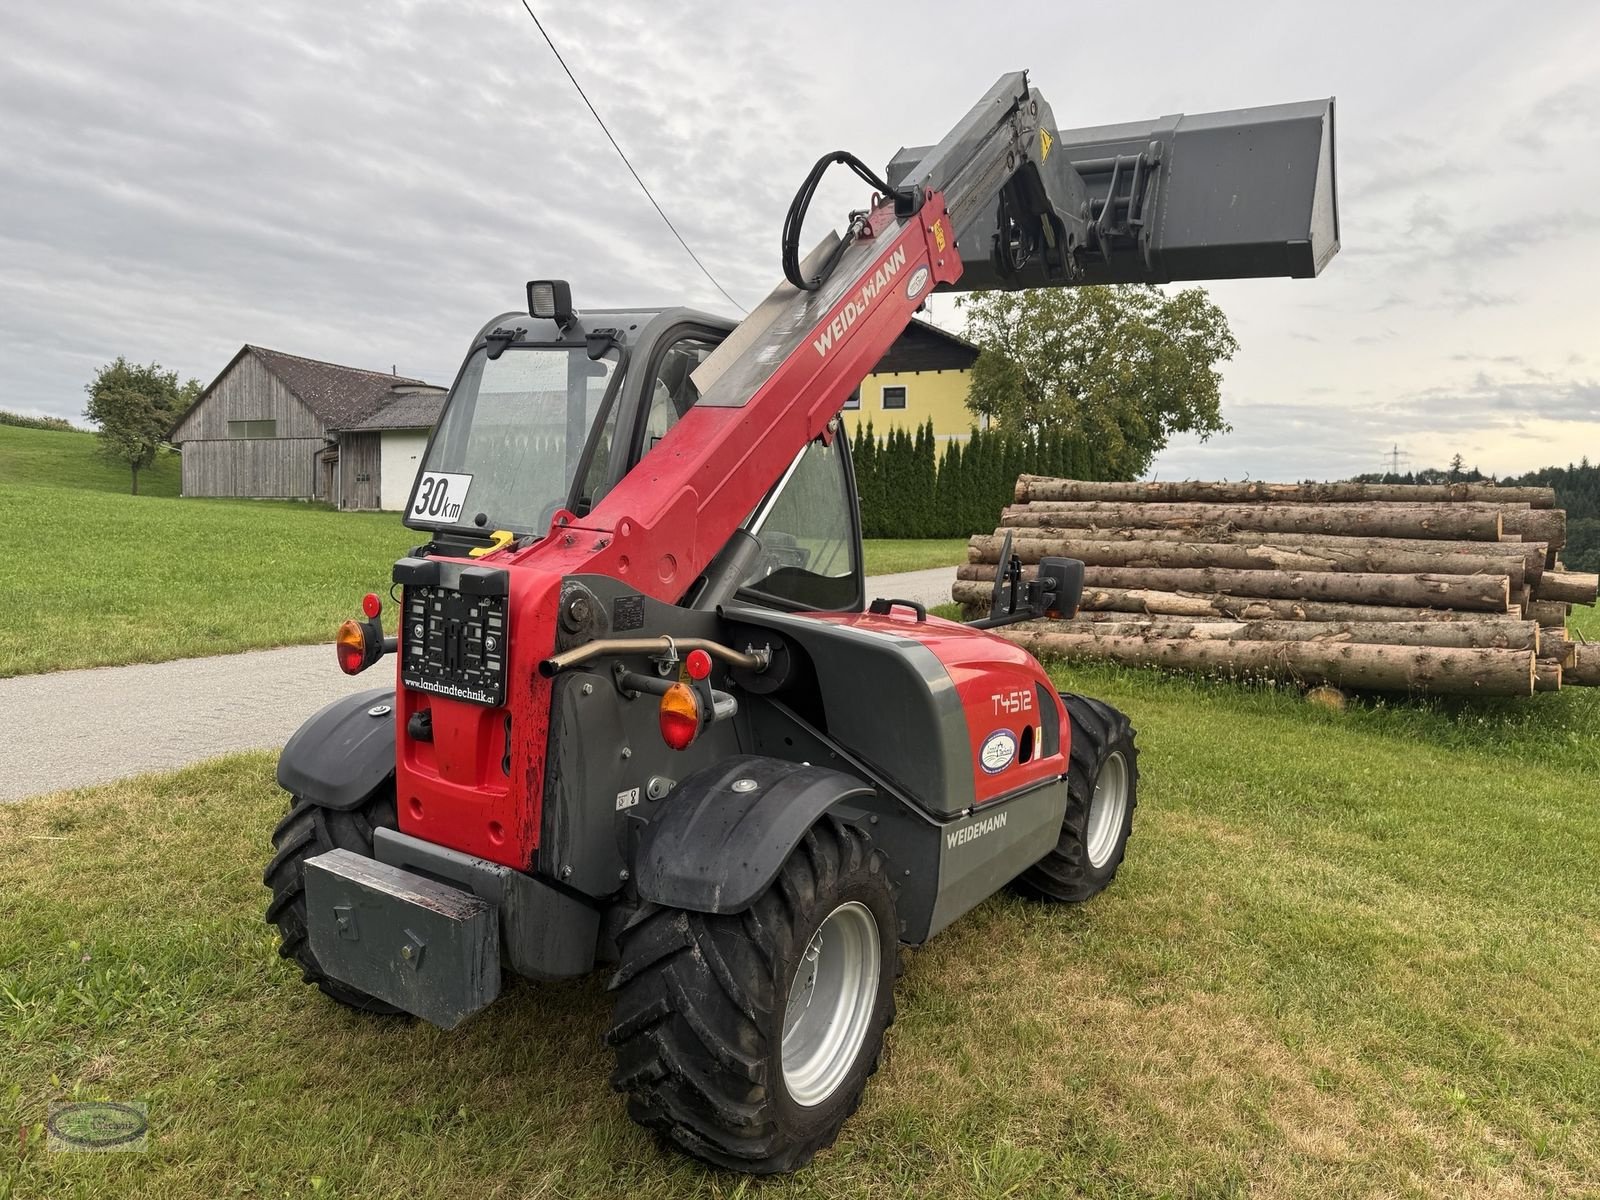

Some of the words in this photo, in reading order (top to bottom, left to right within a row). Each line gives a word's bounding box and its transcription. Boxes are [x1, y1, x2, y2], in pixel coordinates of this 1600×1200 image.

[813, 244, 906, 357] WEIDEMANN
[415, 477, 449, 516] 30
[441, 496, 460, 518] km
[404, 677, 494, 704] www.landundtechnik.at
[992, 690, 1032, 716] T4512
[946, 811, 1008, 850] WEIDEMANN
